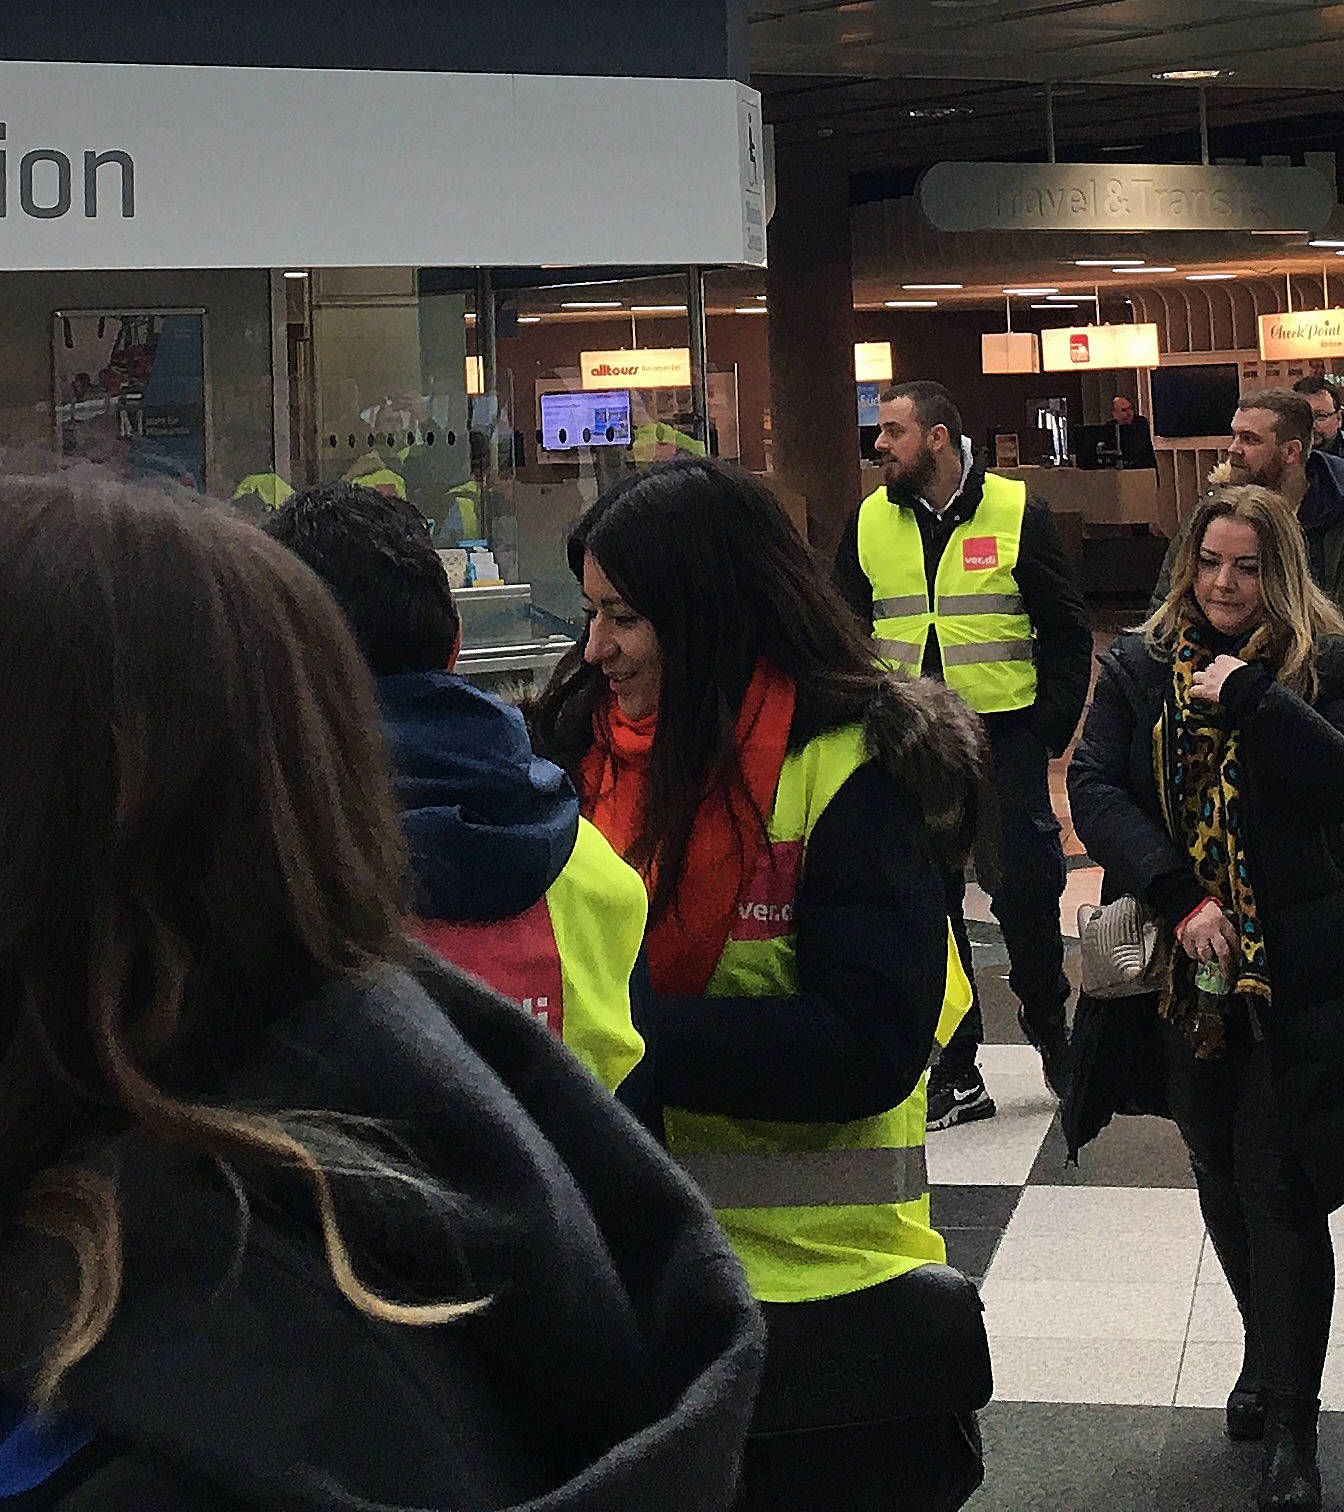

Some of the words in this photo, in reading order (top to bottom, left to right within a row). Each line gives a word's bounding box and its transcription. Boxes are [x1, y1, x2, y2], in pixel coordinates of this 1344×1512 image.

[1104, 178, 1130, 217] &
[590, 364, 639, 377] alltours
[965, 555, 996, 565] ver.di
